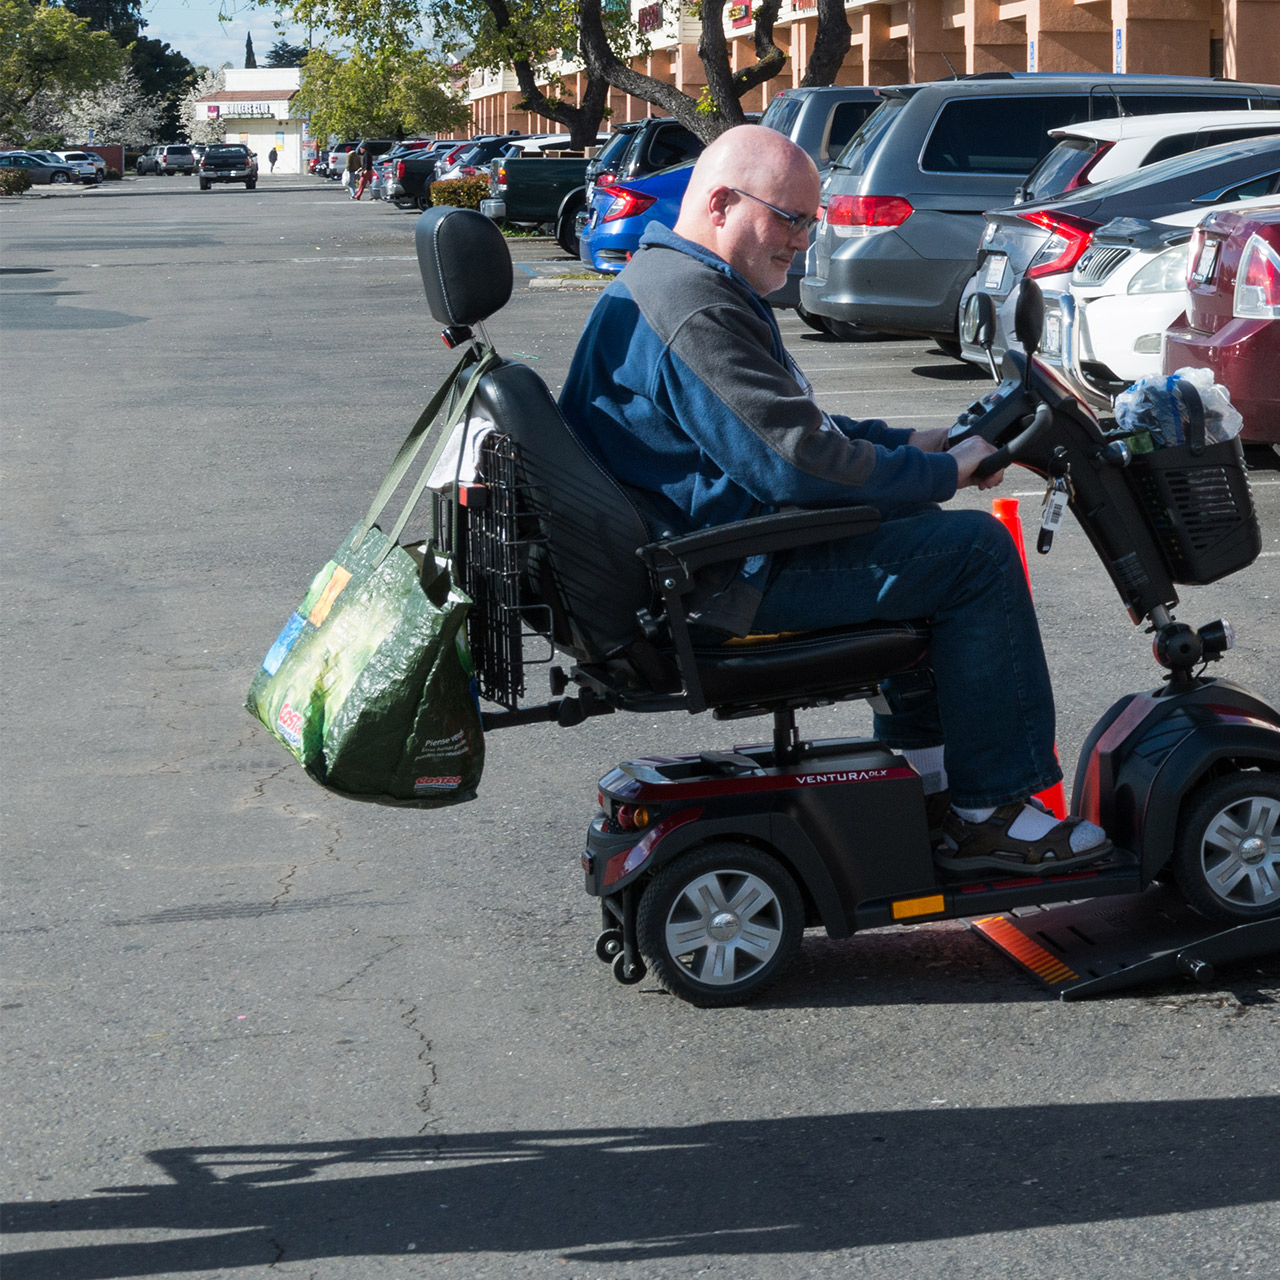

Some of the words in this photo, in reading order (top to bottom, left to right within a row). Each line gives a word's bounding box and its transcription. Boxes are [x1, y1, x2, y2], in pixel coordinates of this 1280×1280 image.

[416, 776, 462, 785] COSTCO
[796, 771, 869, 784] VENTURA
[868, 769, 888, 777] DLX
